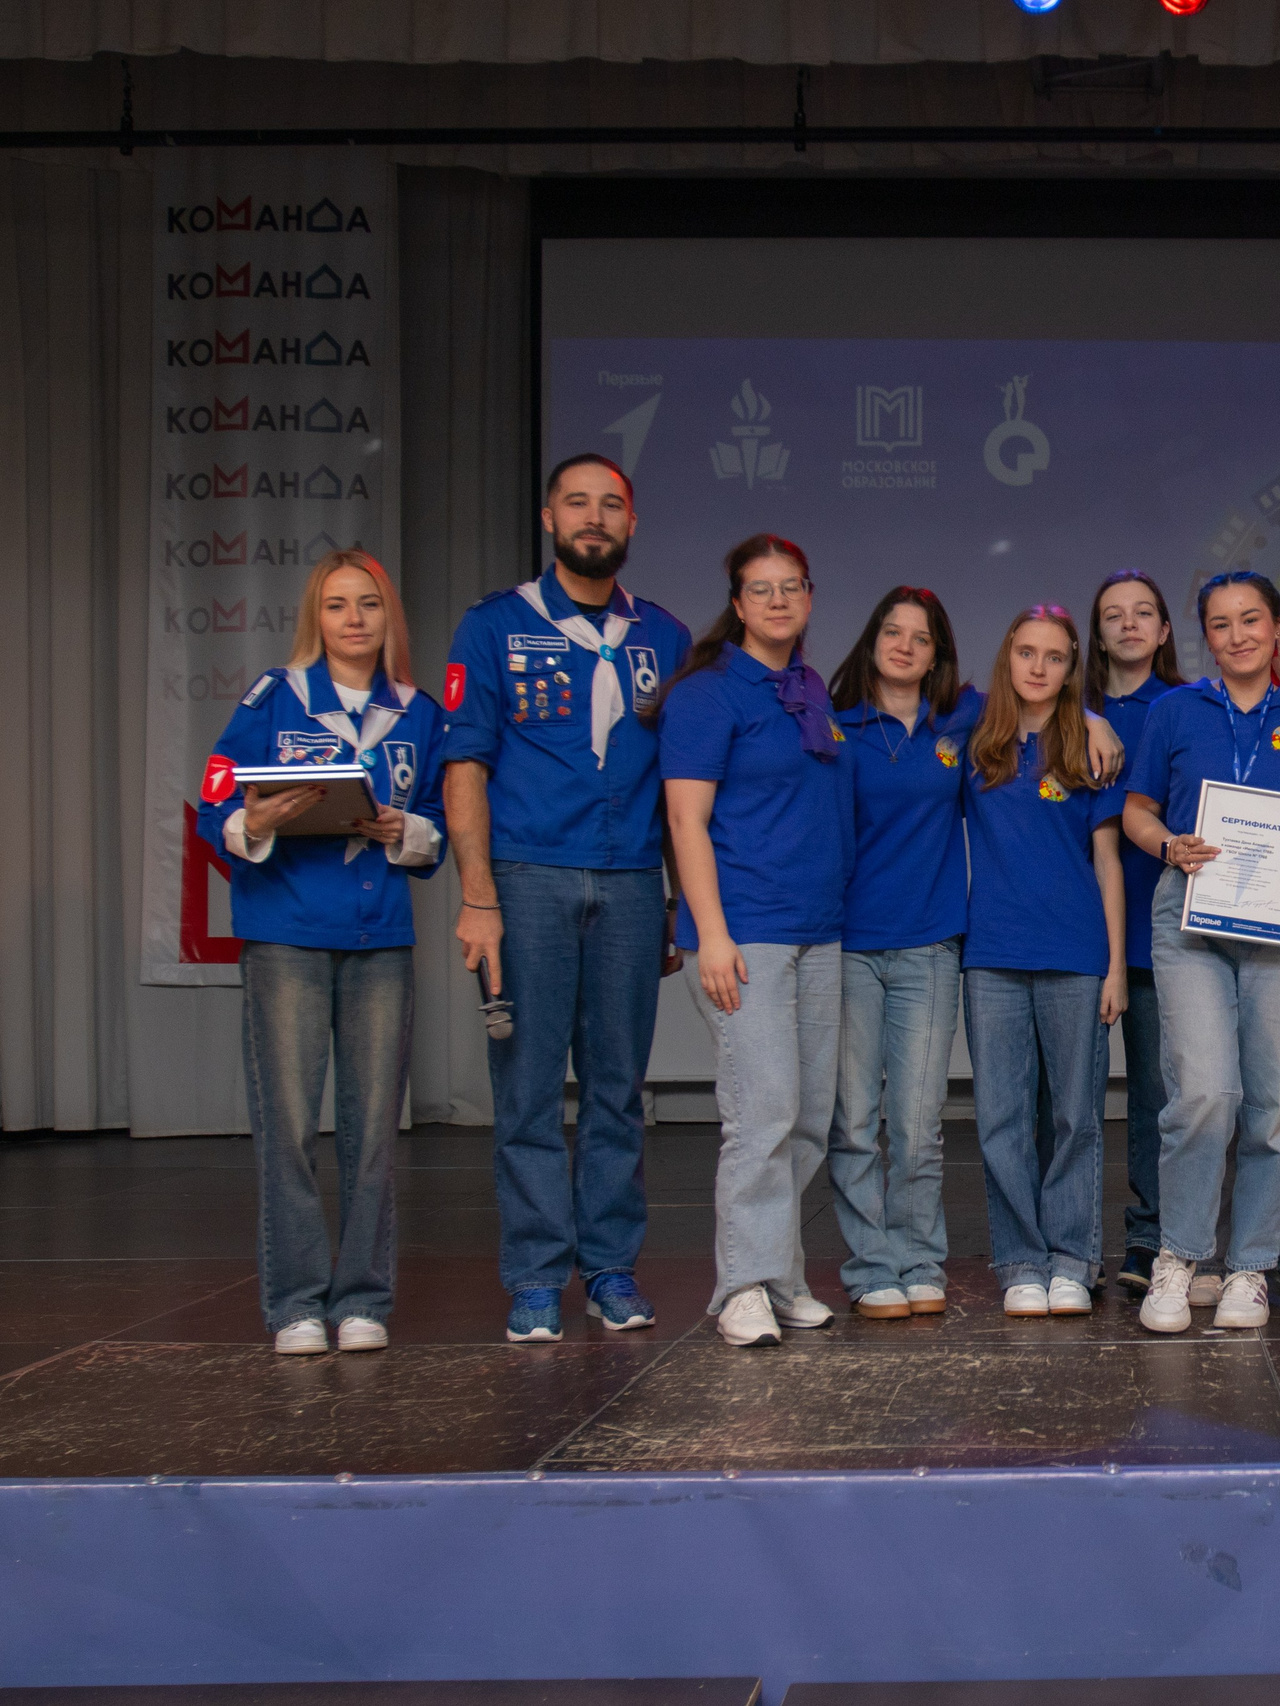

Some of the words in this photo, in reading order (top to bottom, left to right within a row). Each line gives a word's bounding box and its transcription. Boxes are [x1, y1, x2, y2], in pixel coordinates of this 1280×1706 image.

[167, 195, 371, 234] КОМАНДА
[167, 262, 371, 300] КОМАНДА
[167, 329, 371, 367] КОМАНДА
[598, 371, 663, 388] Первые
[166, 395, 370, 434] КОМАНДА
[165, 462, 369, 500] КОМАНДА
[842, 460, 937, 474] МОСКОВСКОЕ
[842, 475, 938, 489] ОБРАЗОВАНИЕ
[1190, 914, 1222, 927] Первые
